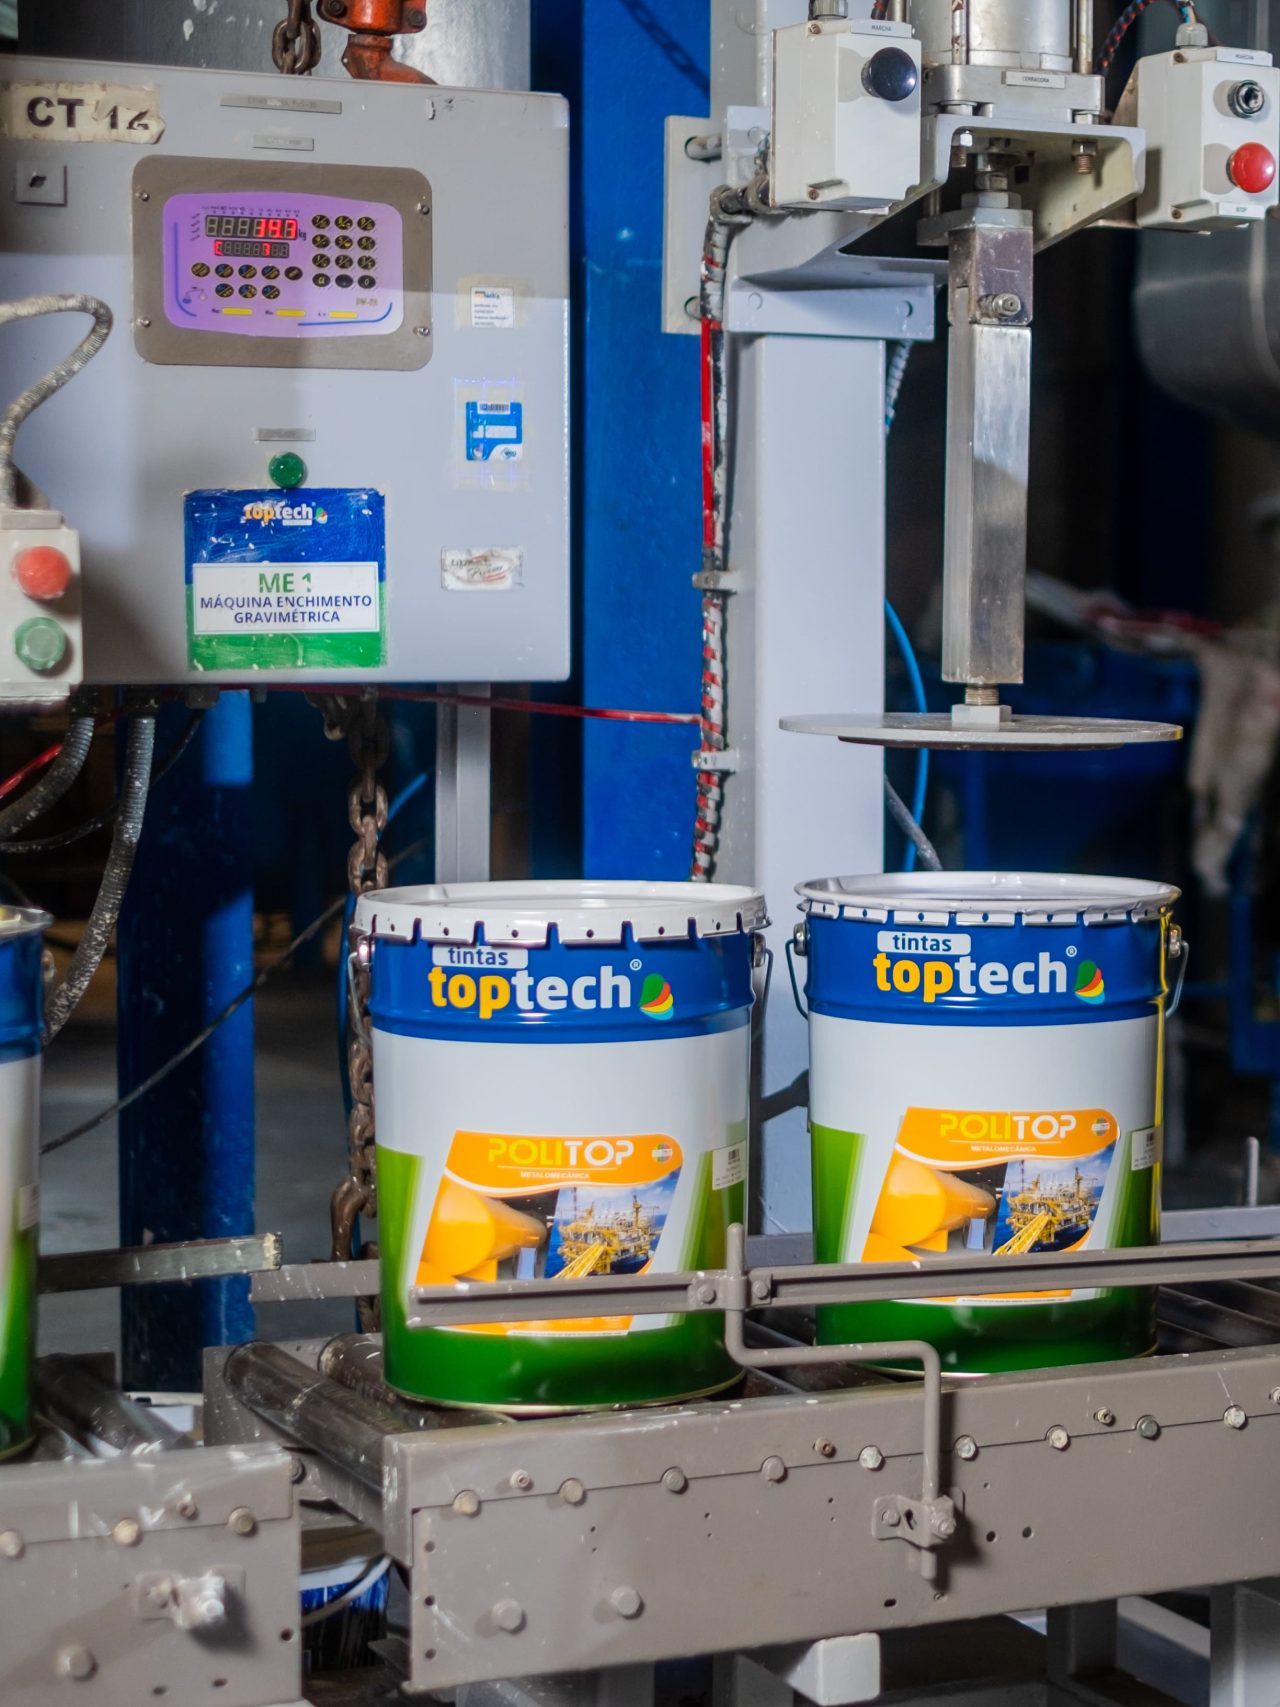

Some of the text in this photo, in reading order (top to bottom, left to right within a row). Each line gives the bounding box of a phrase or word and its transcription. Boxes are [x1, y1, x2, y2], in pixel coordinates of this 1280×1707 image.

[26, 96, 85, 129] CT
[258, 573, 312, 593] ME 1
[200, 594, 372, 610] MÁQUINA ENCHIMENTO
[234, 608, 340, 624] GRAVIMÉTRICA
[892, 933, 952, 952] tintas
[447, 946, 508, 966] tintas
[873, 951, 1067, 1003] toptech
[427, 965, 631, 1019] toptech
[940, 1113, 1077, 1140] POLITOP
[488, 1138, 634, 1166] POLITOP
